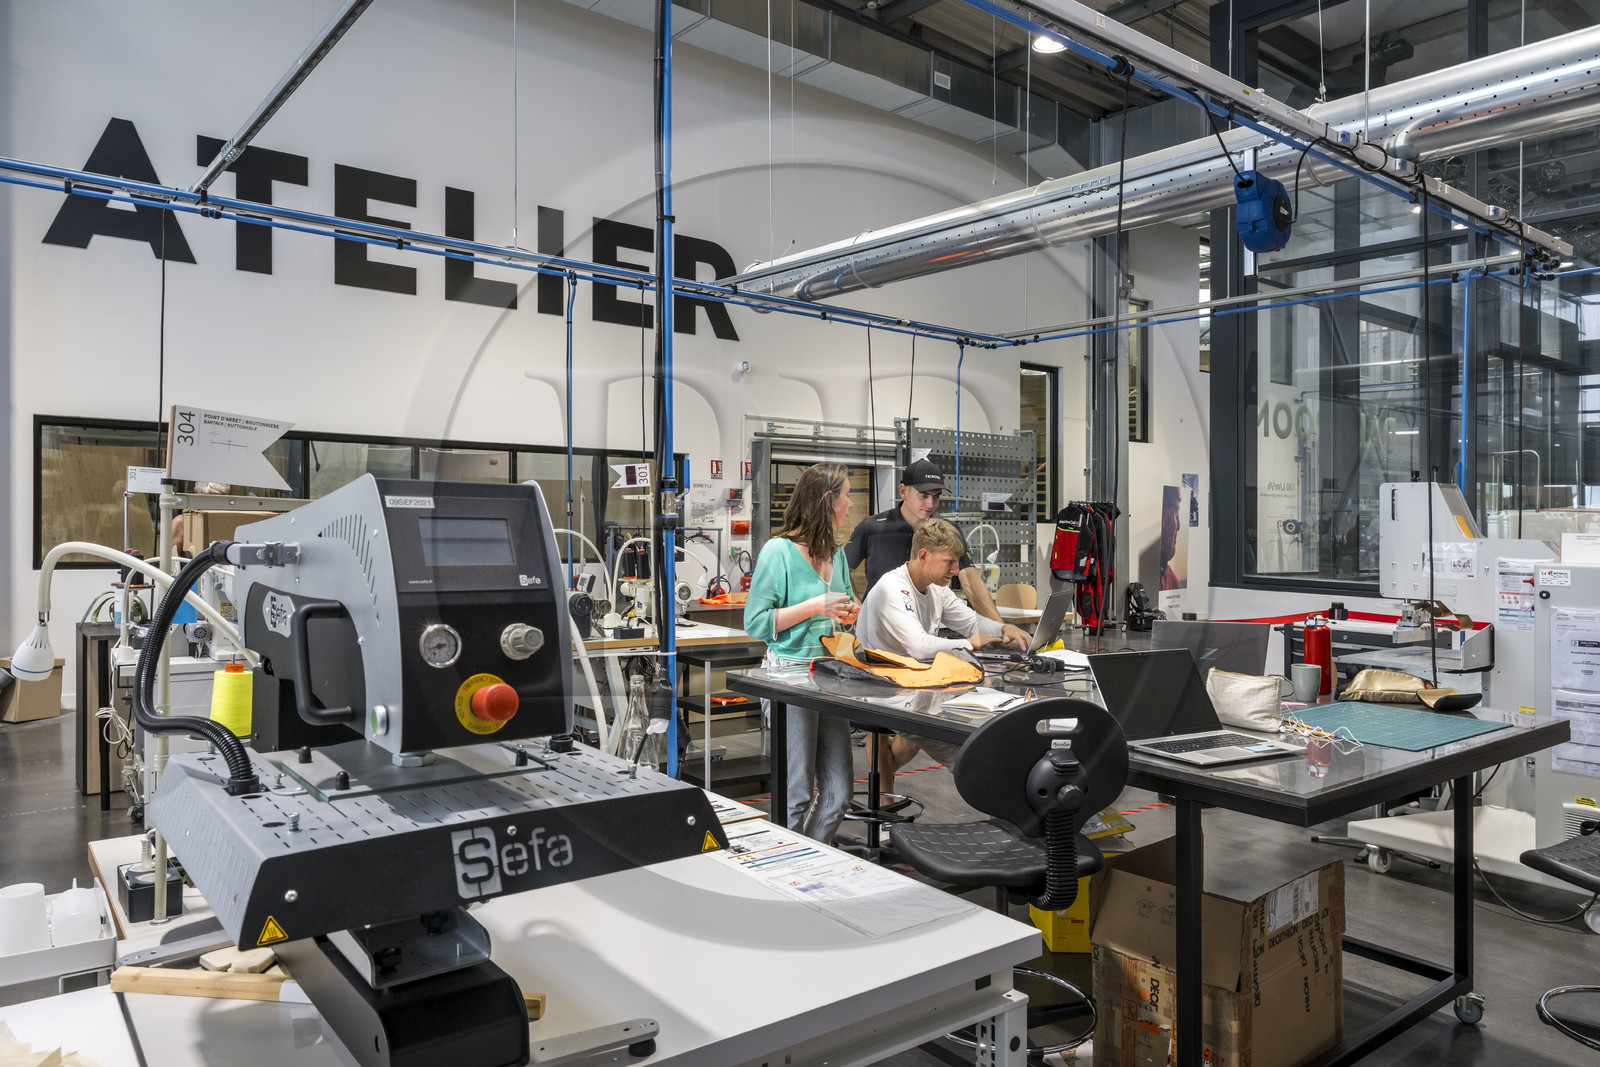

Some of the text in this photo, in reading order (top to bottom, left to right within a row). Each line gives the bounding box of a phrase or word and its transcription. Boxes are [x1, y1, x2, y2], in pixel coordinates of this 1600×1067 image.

[41, 116, 741, 341] ATELIER
[177, 411, 196, 446] 304
[203, 413, 220, 421] POINT
[220, 415, 242, 424] D'ARRET
[245, 419, 280, 430] BOUTONNIERE
[203, 419, 224, 427] BARTACK
[227, 422, 258, 432] BUTTONHOLE
[638, 465, 649, 485] 301
[388, 499, 431, 507] 09SEF2021
[519, 574, 541, 587] Sefa
[270, 596, 287, 628] Sefa
[463, 676, 489, 692] EMERGENCY
[451, 825, 574, 899] Sefa
[1268, 924, 1299, 949] DECATHLON
